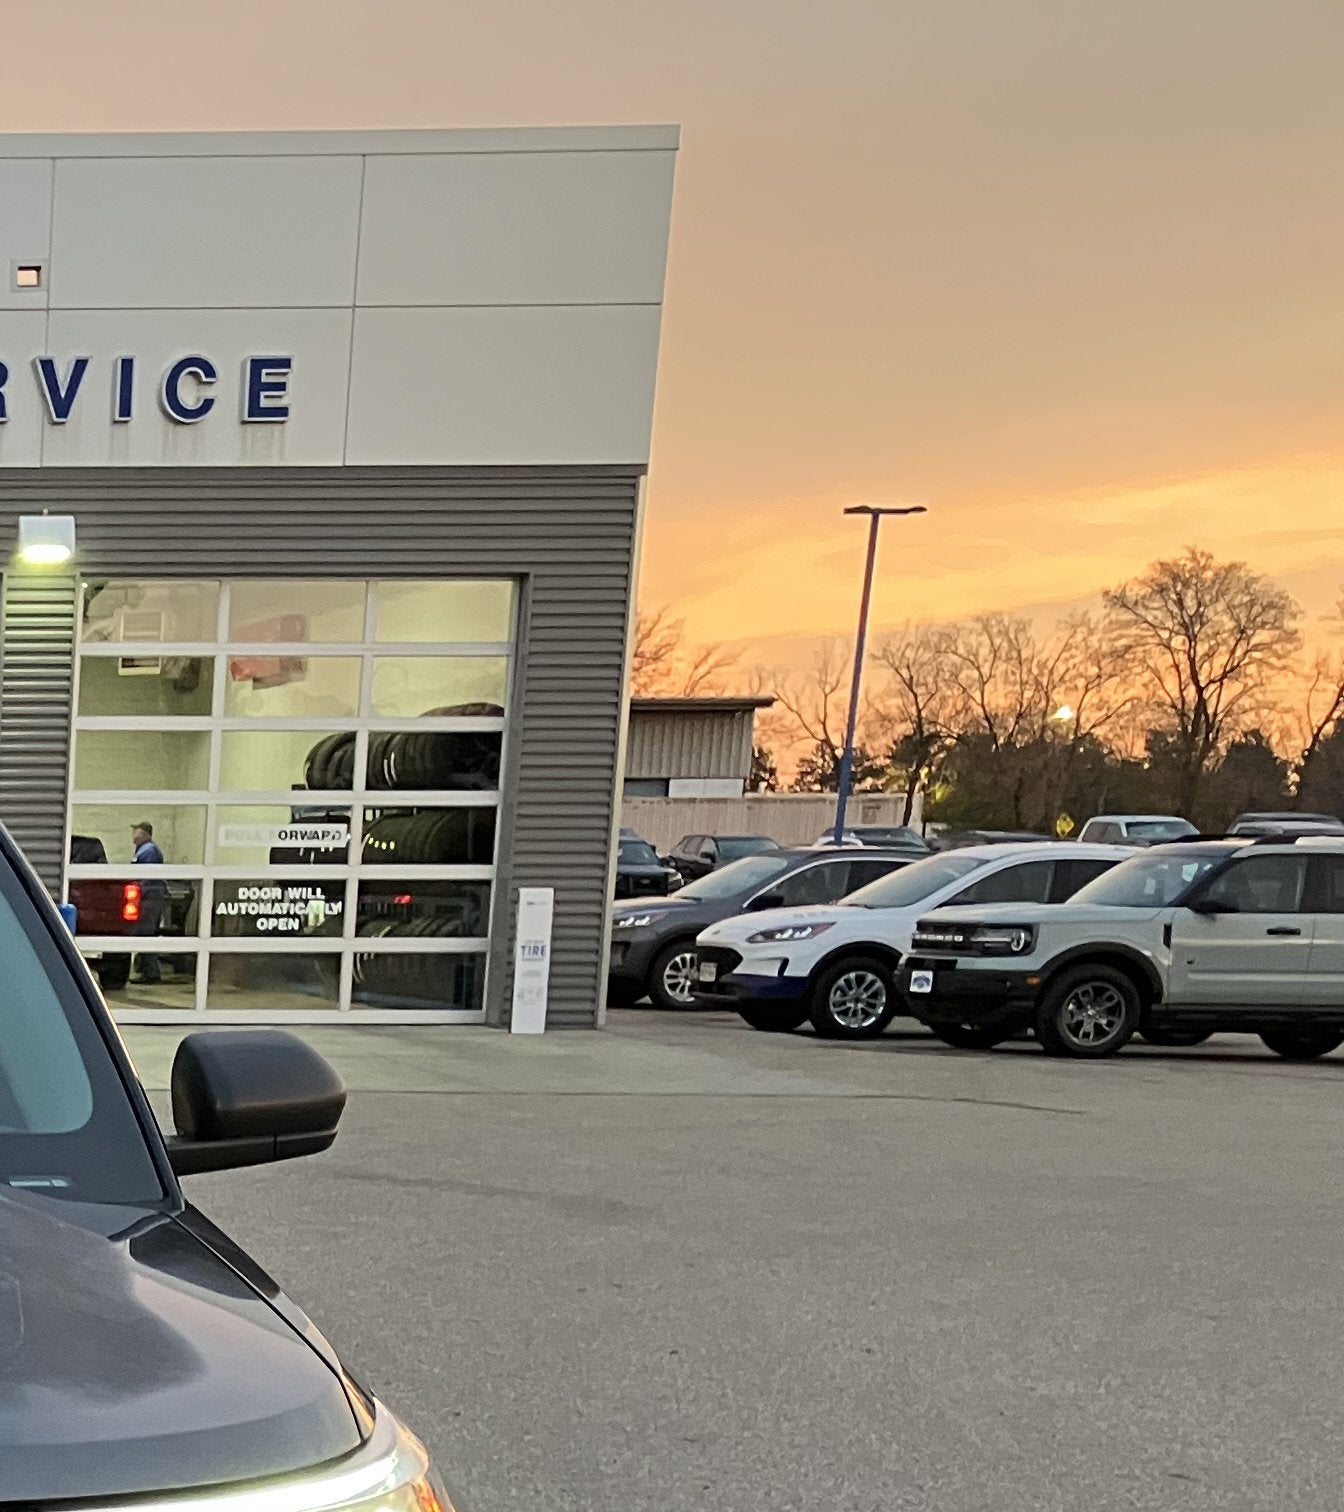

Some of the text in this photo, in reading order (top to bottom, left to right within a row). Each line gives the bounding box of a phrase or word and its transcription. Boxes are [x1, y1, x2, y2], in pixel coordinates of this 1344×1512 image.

[269, 829, 342, 841] ORWARD
[238, 887, 325, 900] DOOR WILL
[215, 901, 343, 915] AUTOMATICALY
[256, 918, 300, 931] OPEN
[520, 945, 546, 956] TIRE
